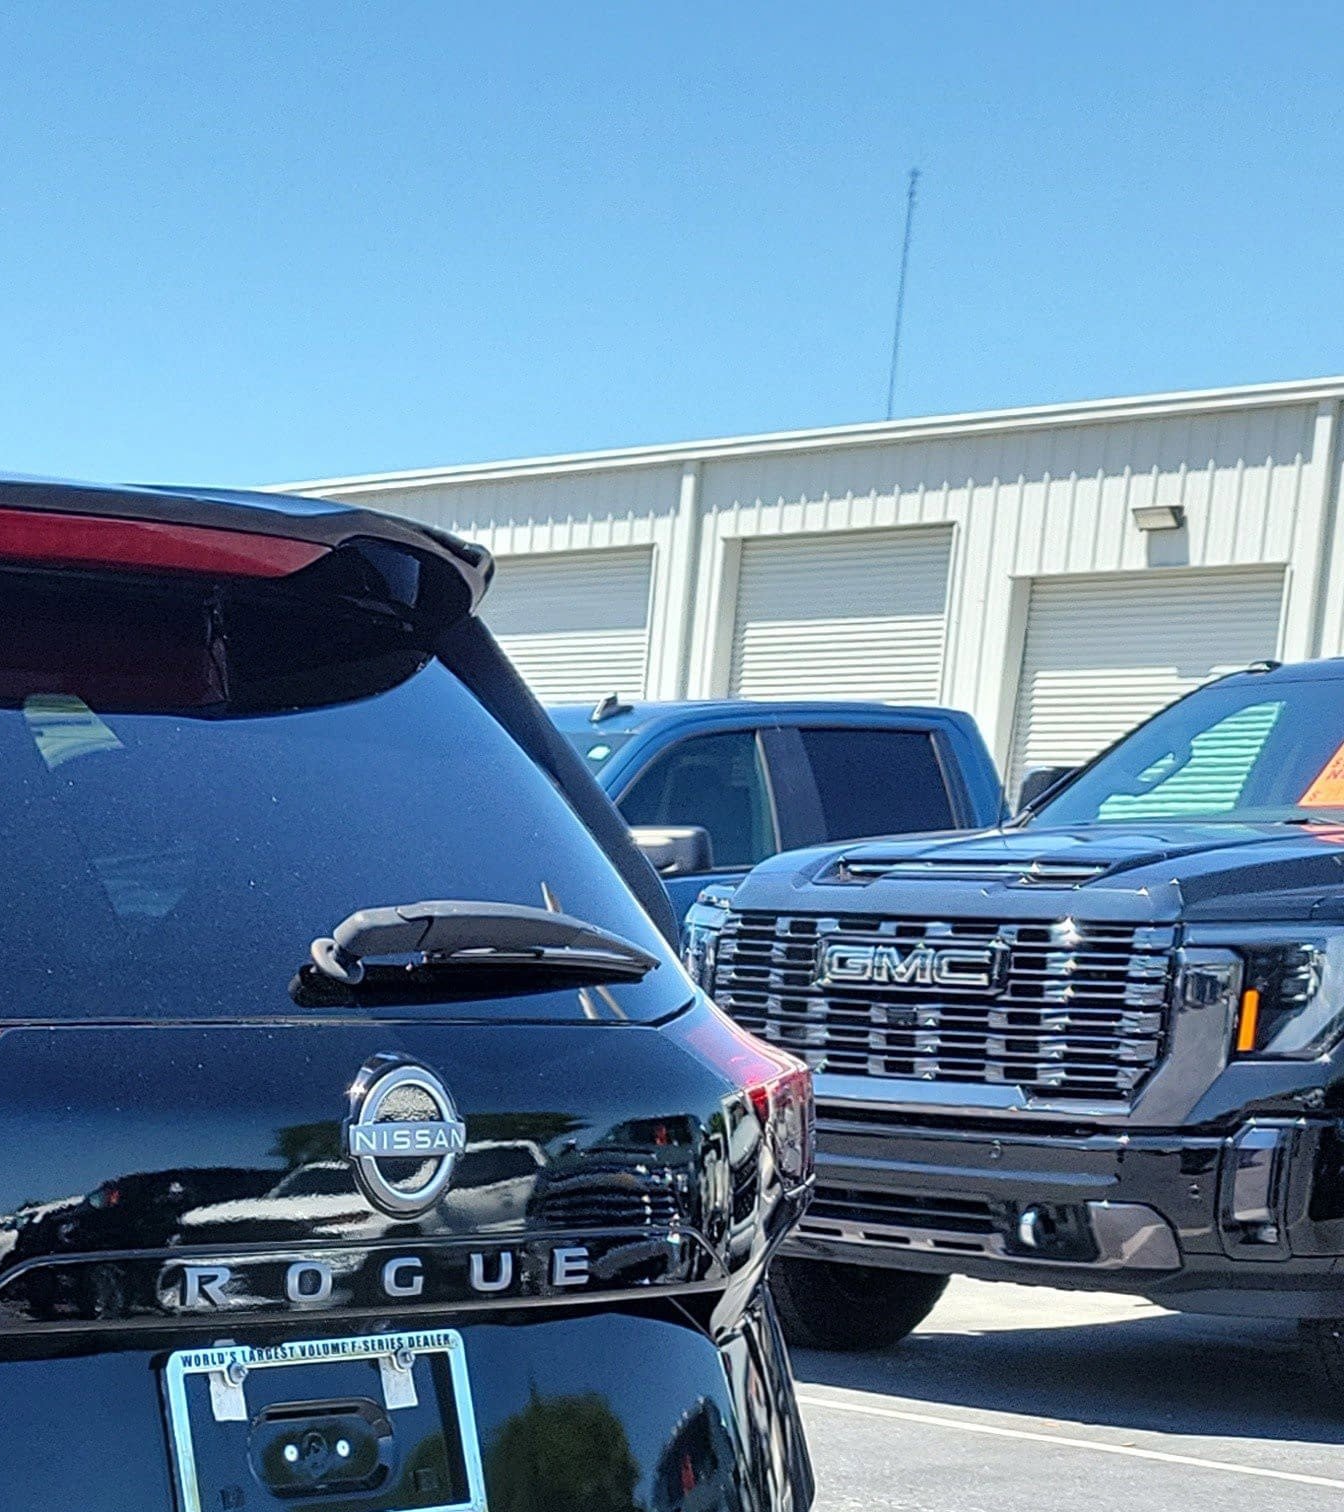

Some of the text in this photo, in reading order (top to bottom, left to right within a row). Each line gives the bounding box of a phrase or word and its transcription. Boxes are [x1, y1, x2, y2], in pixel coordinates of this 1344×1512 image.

[824, 944, 993, 986] GMC
[355, 1128, 464, 1152] NISSAN
[184, 1247, 590, 1307] ROGUE
[180, 1351, 237, 1368] WORLD'S
[241, 1345, 296, 1364] LARGEST
[299, 1341, 347, 1359] VOLUME
[408, 1333, 452, 1349] DEALER
